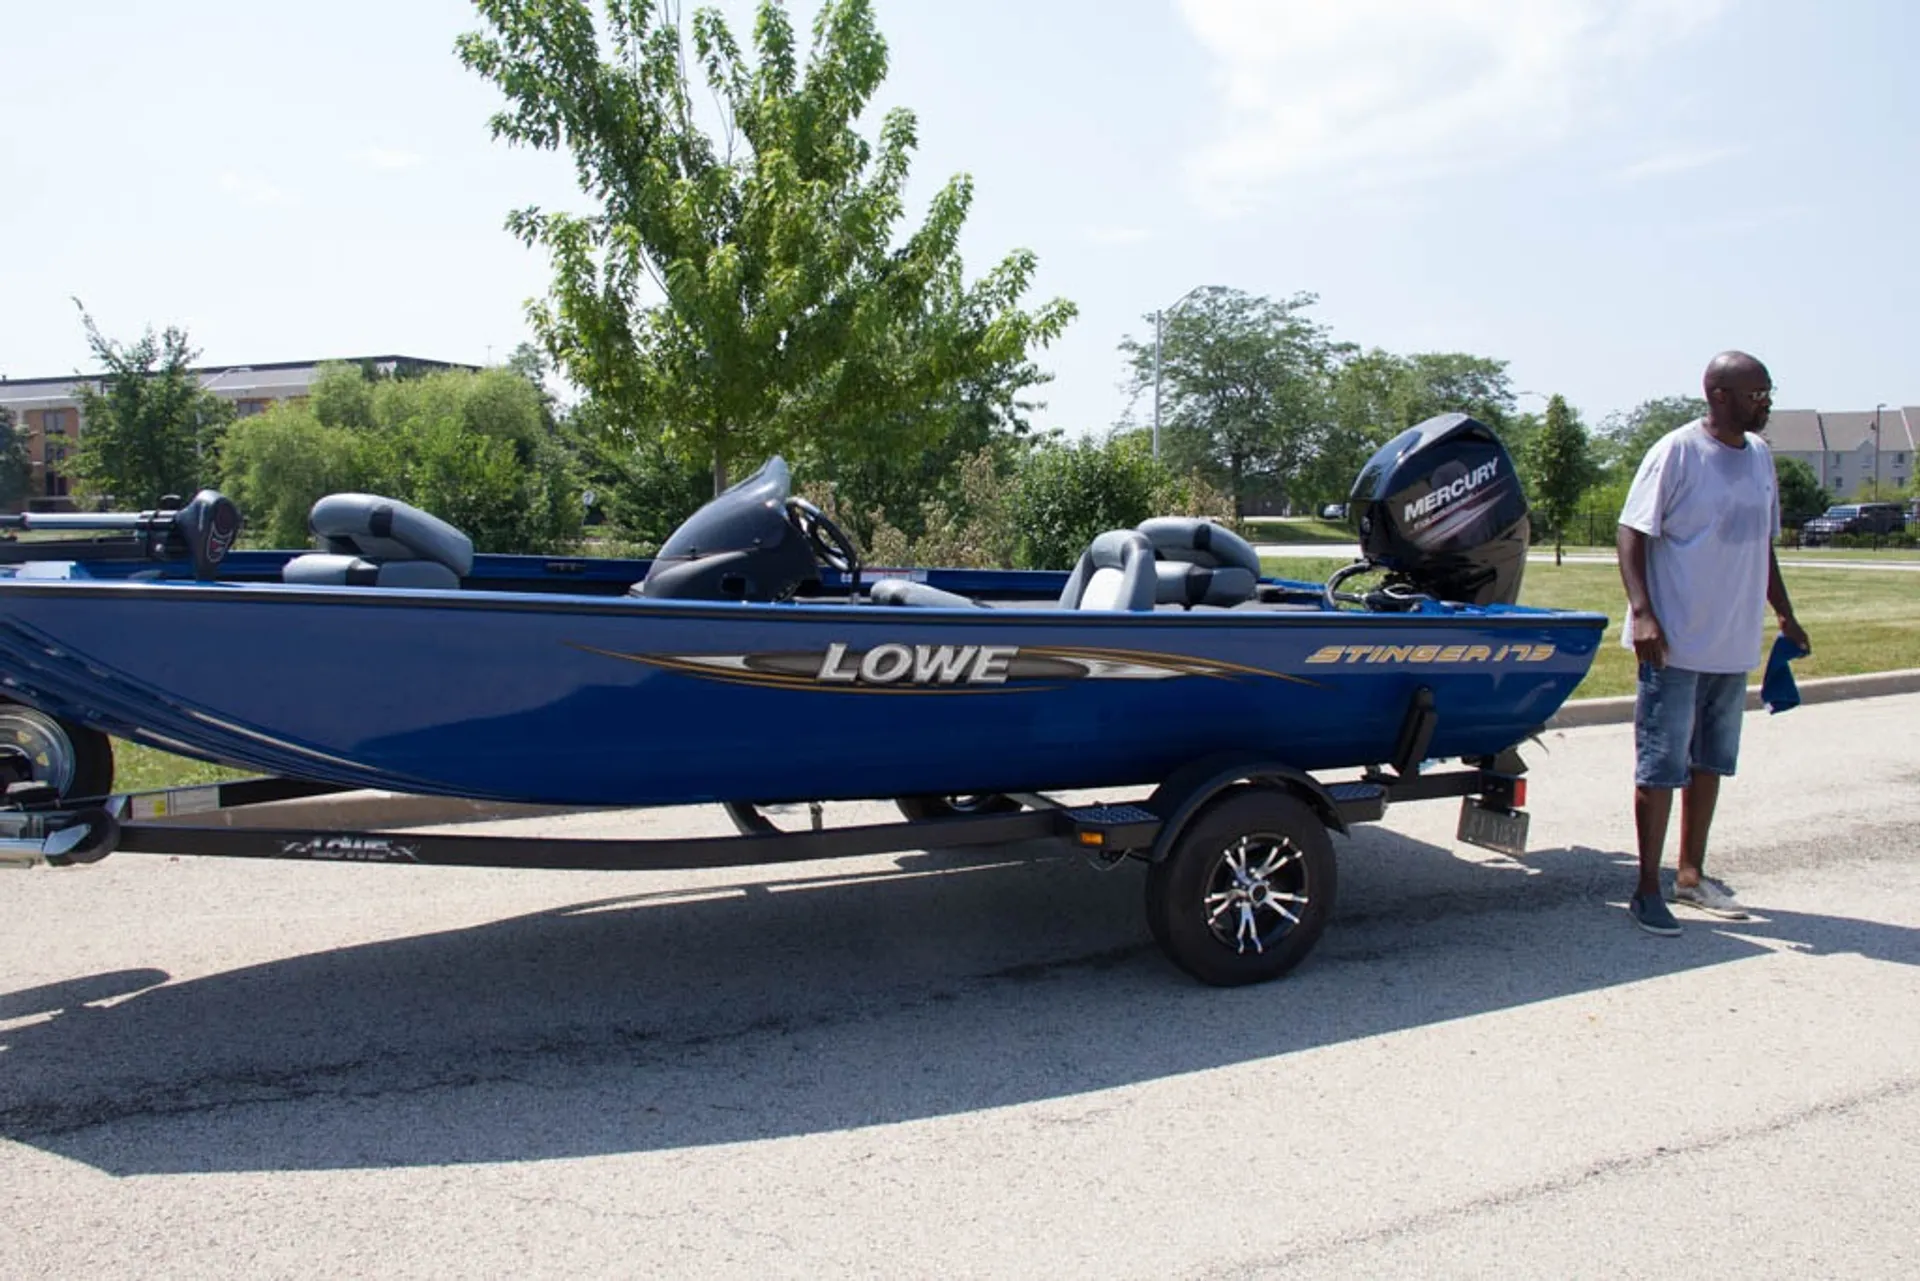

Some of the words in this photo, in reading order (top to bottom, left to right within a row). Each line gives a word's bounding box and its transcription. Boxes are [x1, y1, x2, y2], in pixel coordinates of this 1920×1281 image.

[1404, 457, 1498, 522] MERCURY
[817, 643, 1019, 683] LOWE
[1304, 645, 1491, 663] STINGER
[1493, 645, 1556, 661] 175
